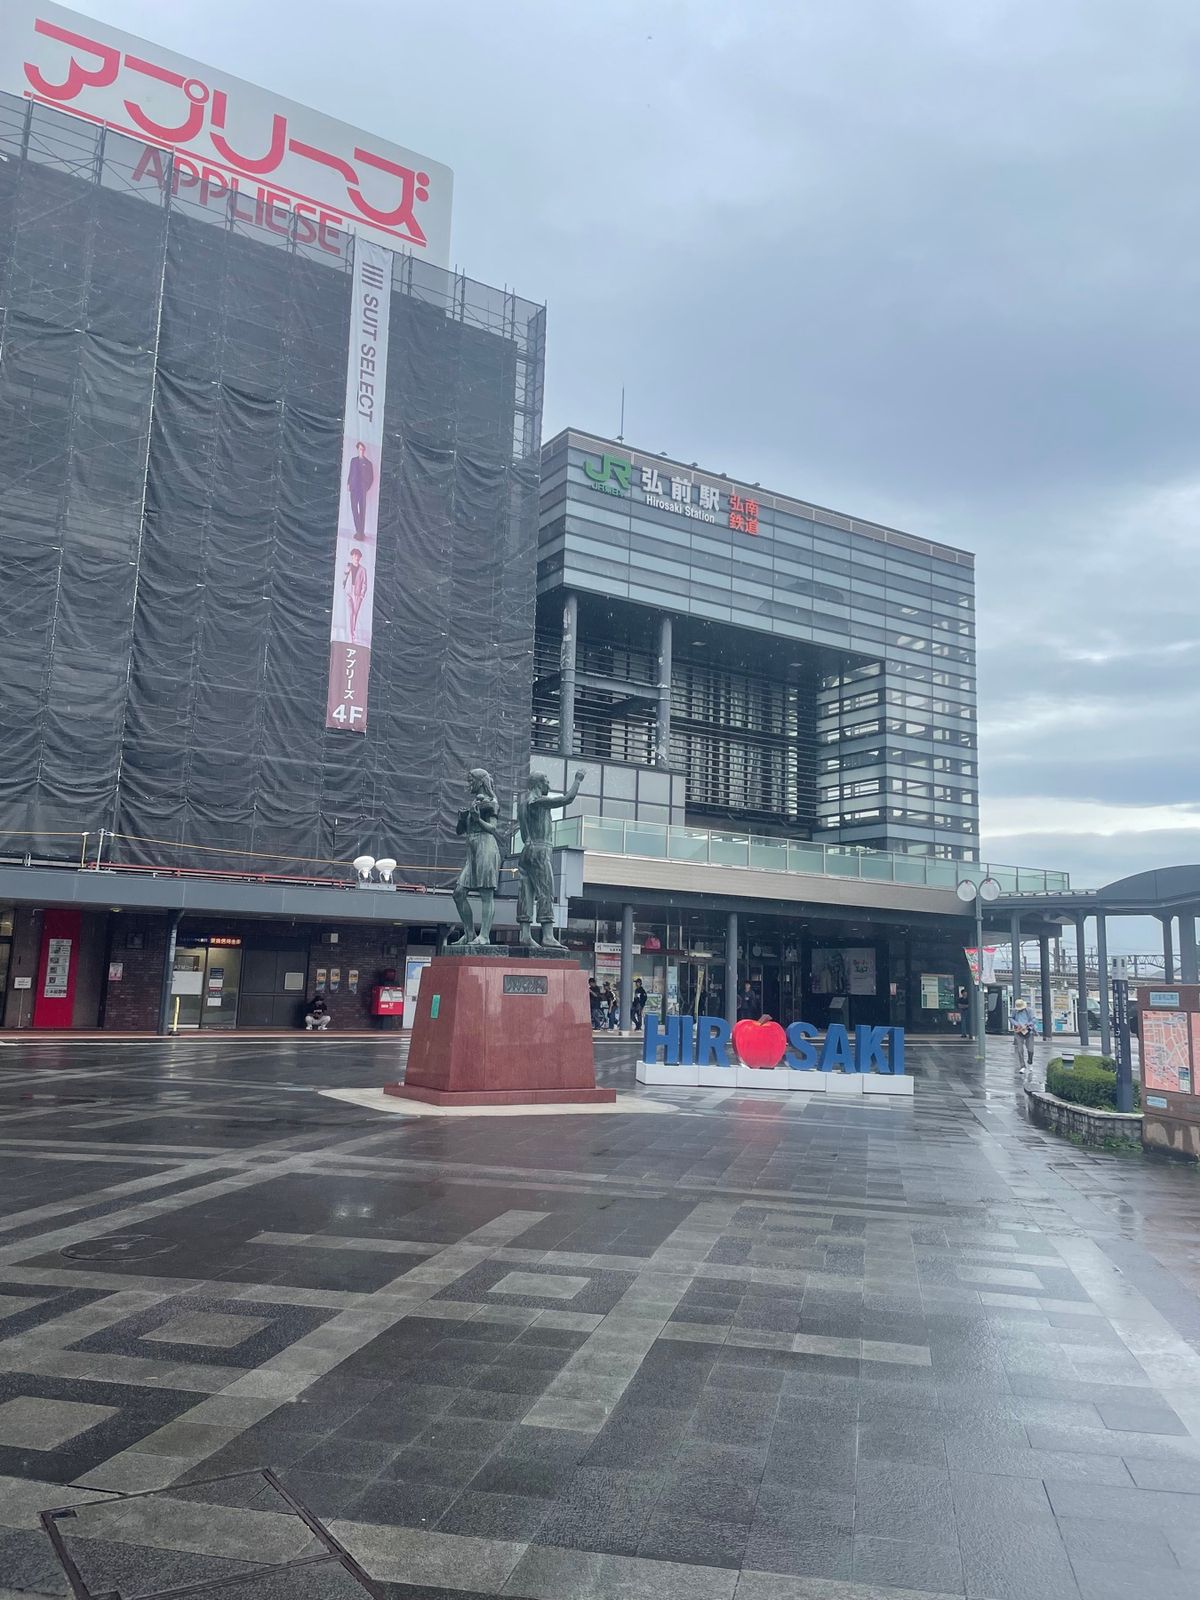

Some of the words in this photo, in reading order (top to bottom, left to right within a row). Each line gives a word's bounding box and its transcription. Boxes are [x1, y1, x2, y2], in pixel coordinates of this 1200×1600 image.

[23, 17, 430, 247] アプリーズ
[131, 145, 343, 255] APPLIESE
[362, 293, 379, 341] SUIT
[358, 343, 376, 423] SELECT
[584, 453, 632, 489] JR
[641, 466, 720, 512] 弘前駅
[646, 495, 682, 514] Hirosaki
[685, 506, 715, 524] Station
[729, 493, 759, 517] 弘南
[729, 512, 760, 535] 鉄道
[332, 704, 364, 724] 4F
[642, 1013, 905, 1075] HIRSAKI
